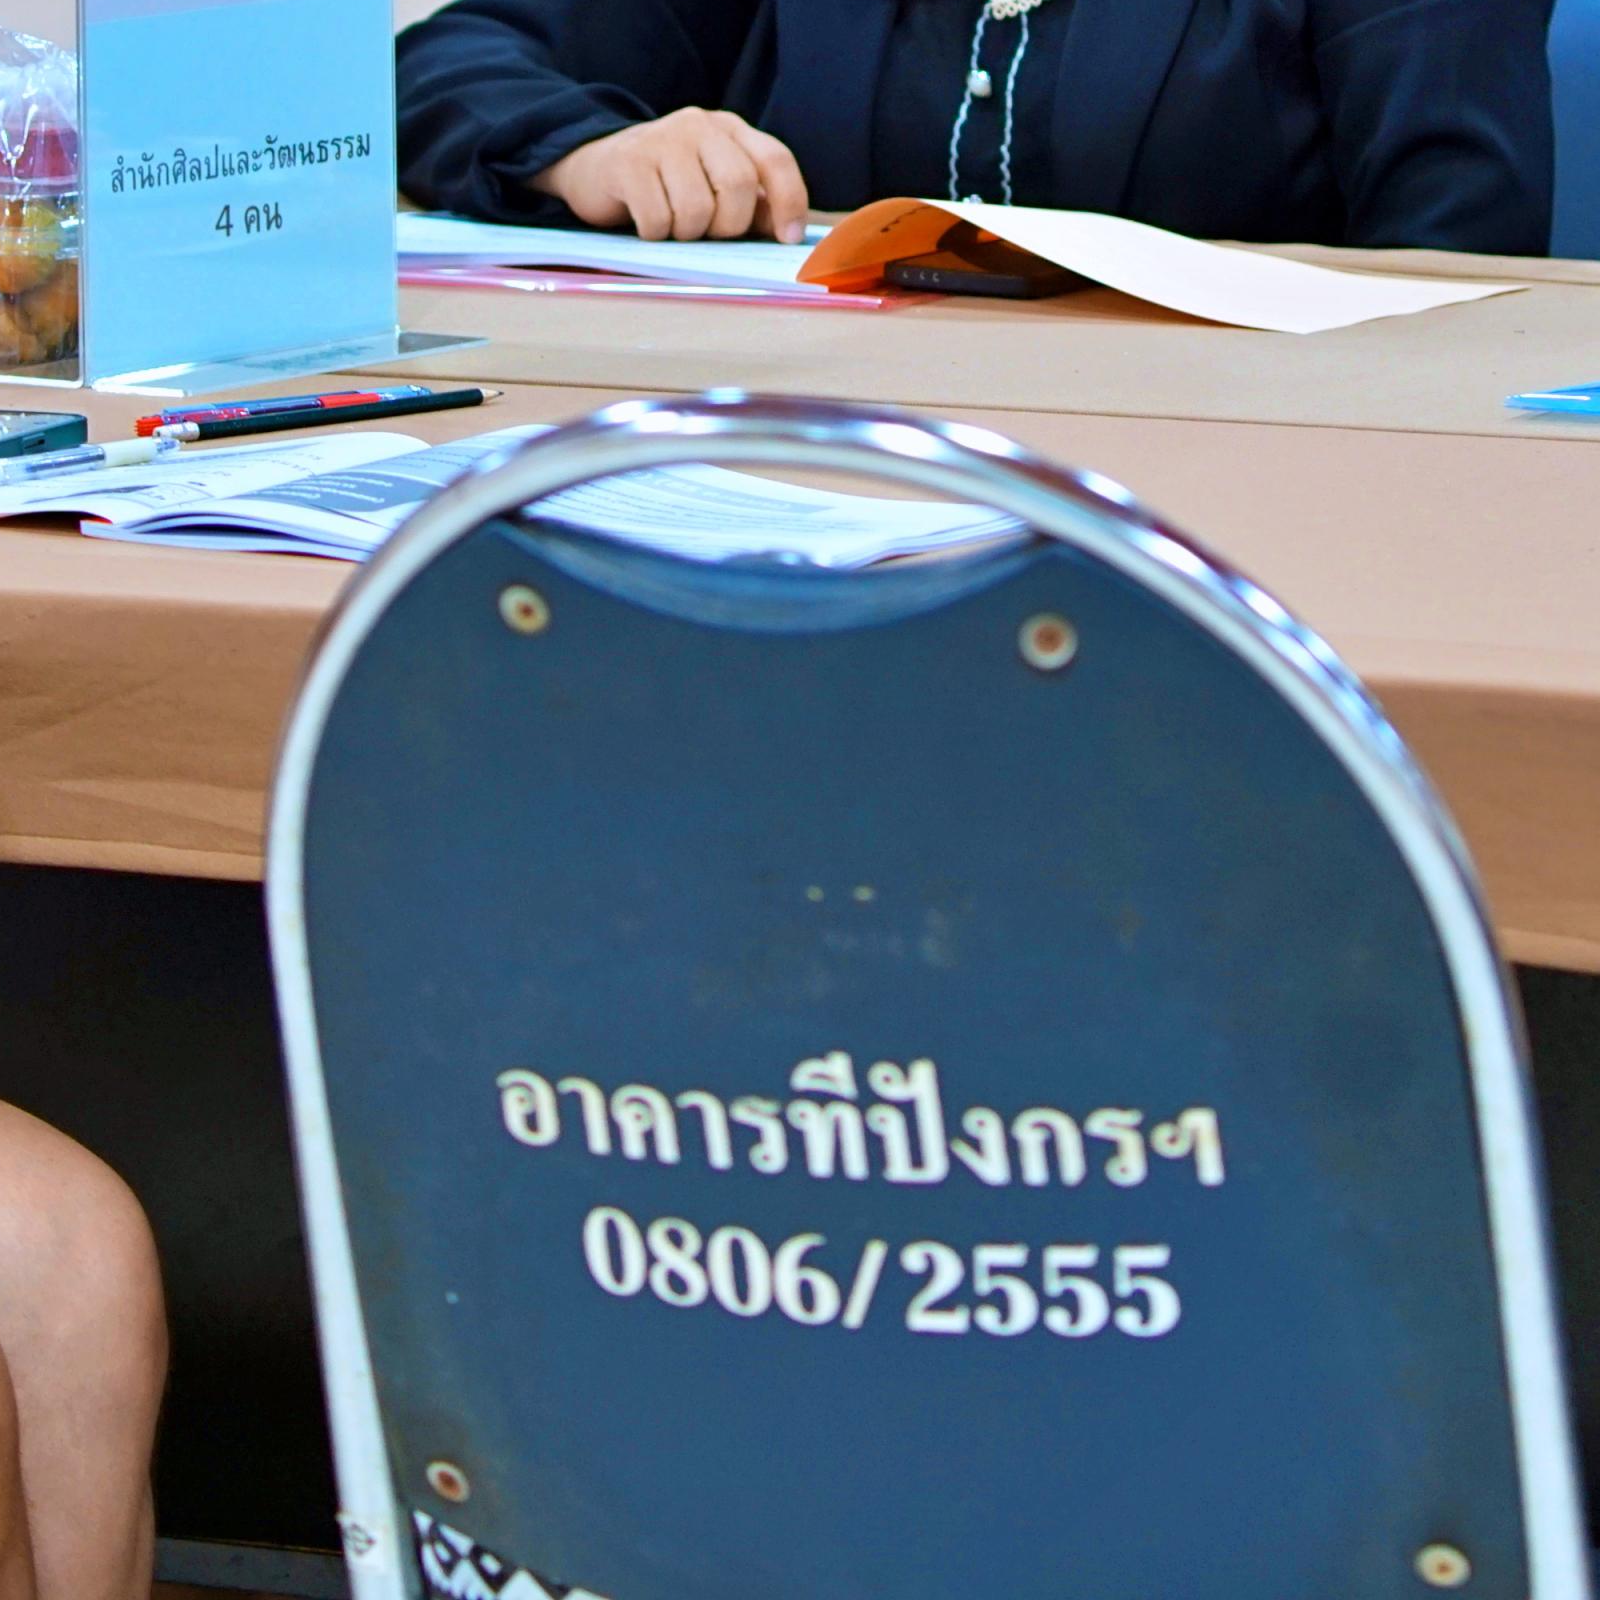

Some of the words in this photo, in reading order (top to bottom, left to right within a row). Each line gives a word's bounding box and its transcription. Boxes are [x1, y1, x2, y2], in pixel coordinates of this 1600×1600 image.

[111, 133, 371, 193] สำนักศิลปและวัฒนธรรม
[215, 204, 234, 237] 4
[244, 201, 283, 234] คน
[582, 1206, 1182, 1338] 0806/2555
